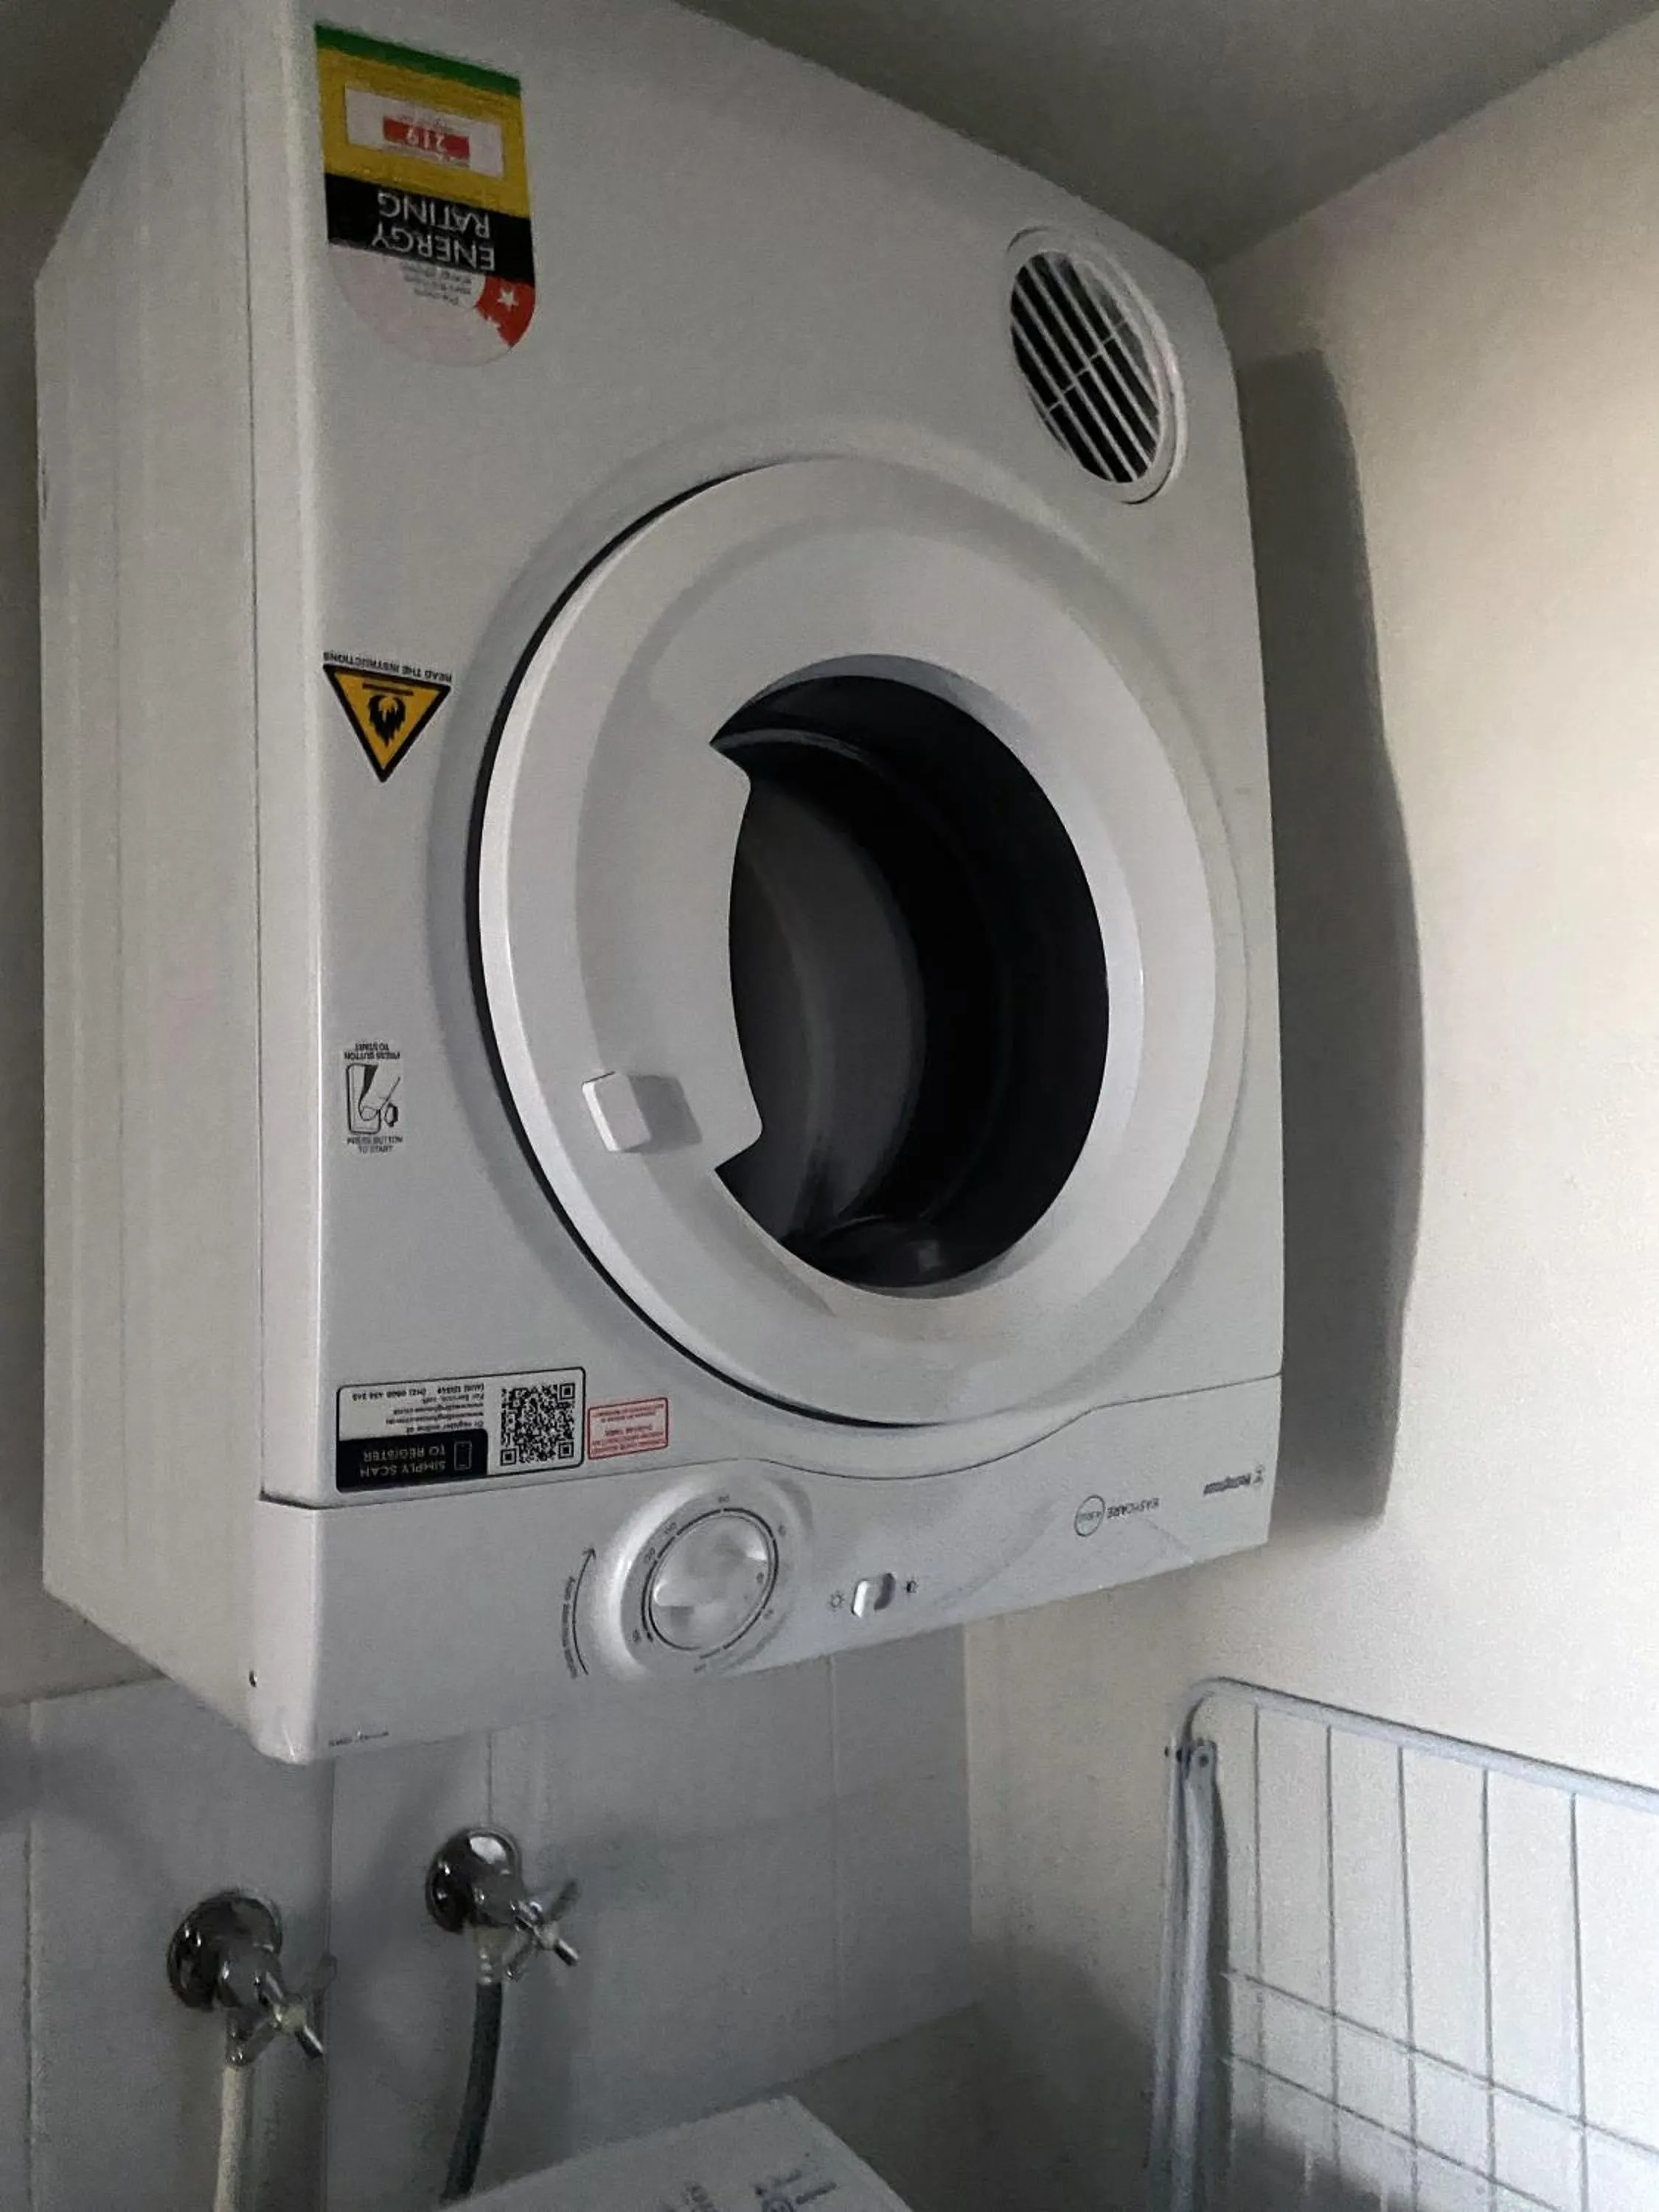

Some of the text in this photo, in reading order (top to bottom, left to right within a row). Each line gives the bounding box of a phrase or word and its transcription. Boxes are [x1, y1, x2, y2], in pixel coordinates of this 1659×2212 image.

[377, 192, 491, 238] RATING
[371, 222, 496, 272] ENERGY
[323, 652, 452, 683] READ THE INSTRUCTIONS
[344, 1051, 375, 1060] BUTTON
[363, 1444, 446, 1462] TO REGISTER
[359, 1460, 446, 1478] SIMPLY SCAN
